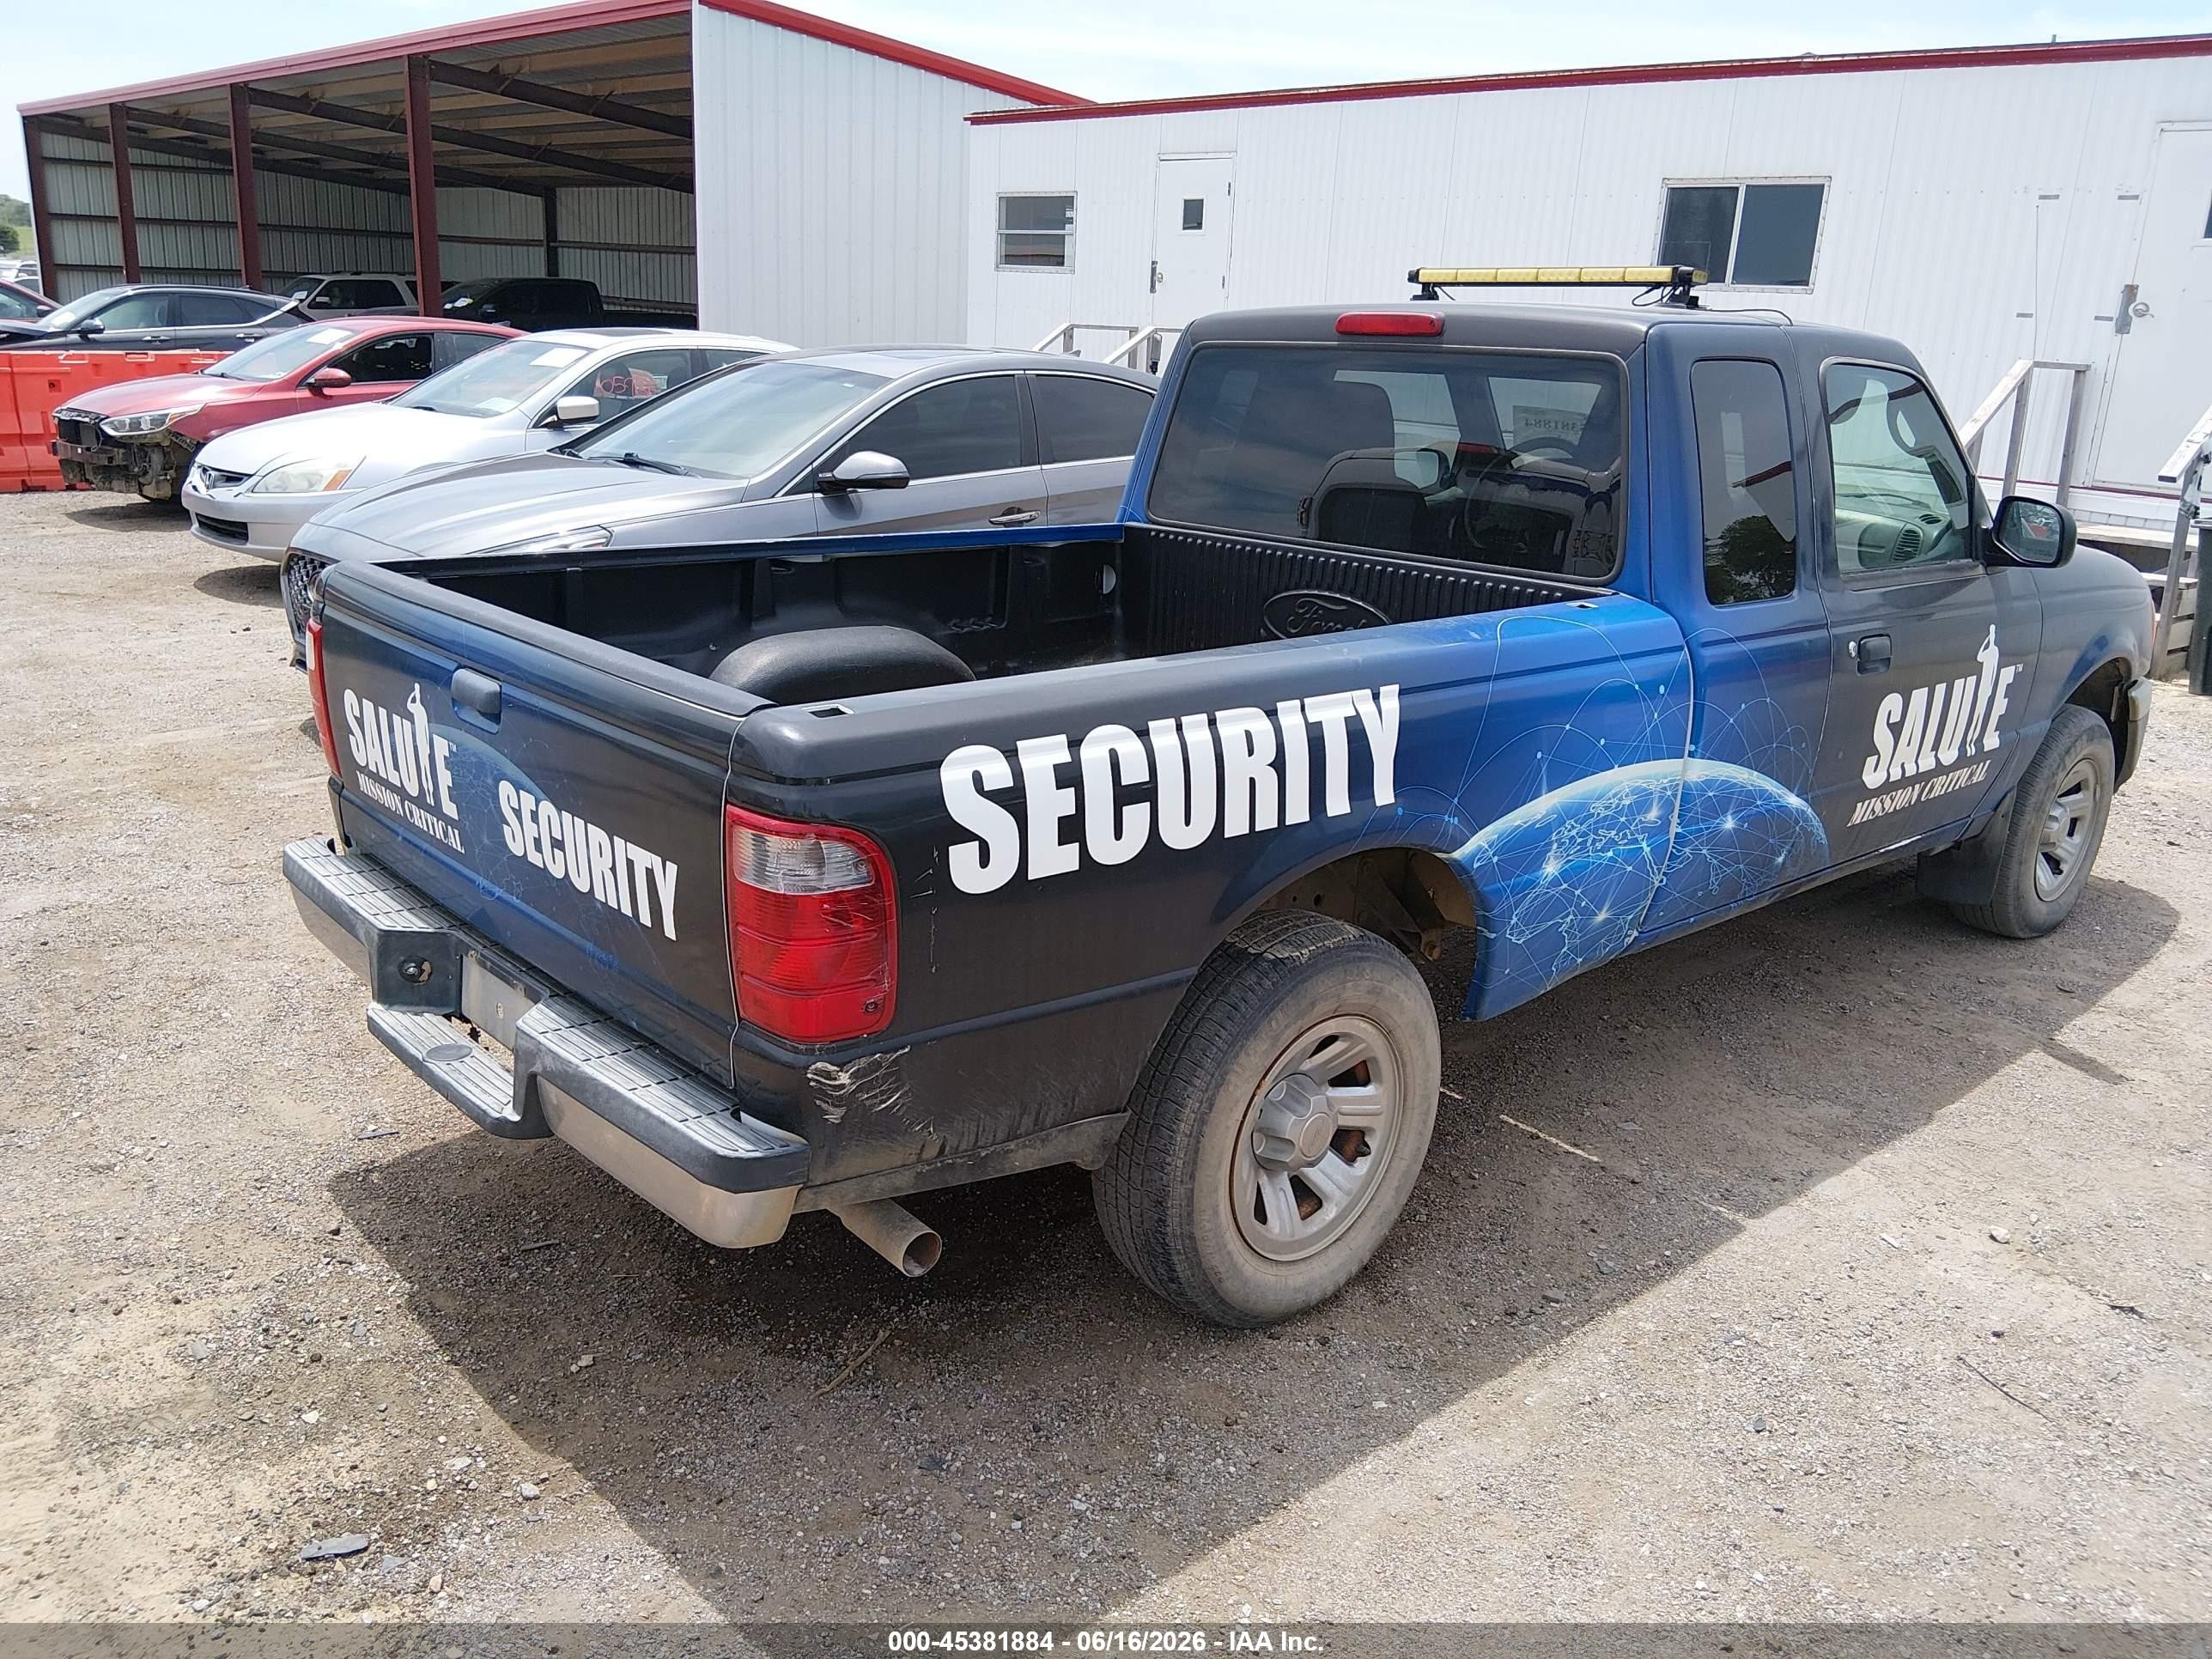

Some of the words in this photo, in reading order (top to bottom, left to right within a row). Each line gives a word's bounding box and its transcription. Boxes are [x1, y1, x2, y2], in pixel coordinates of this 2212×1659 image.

[1287, 598, 1367, 634] Fo
[343, 683, 459, 821] SALUTE
[1862, 624, 2015, 789] SALUTE
[356, 770, 404, 817] MISSION
[404, 800, 465, 854] CRITICAL
[940, 684, 1400, 894] SECURITY
[1847, 781, 1925, 827] MISSION
[1922, 759, 1991, 800] CRITICAL
[498, 779, 678, 941] SECURITY
